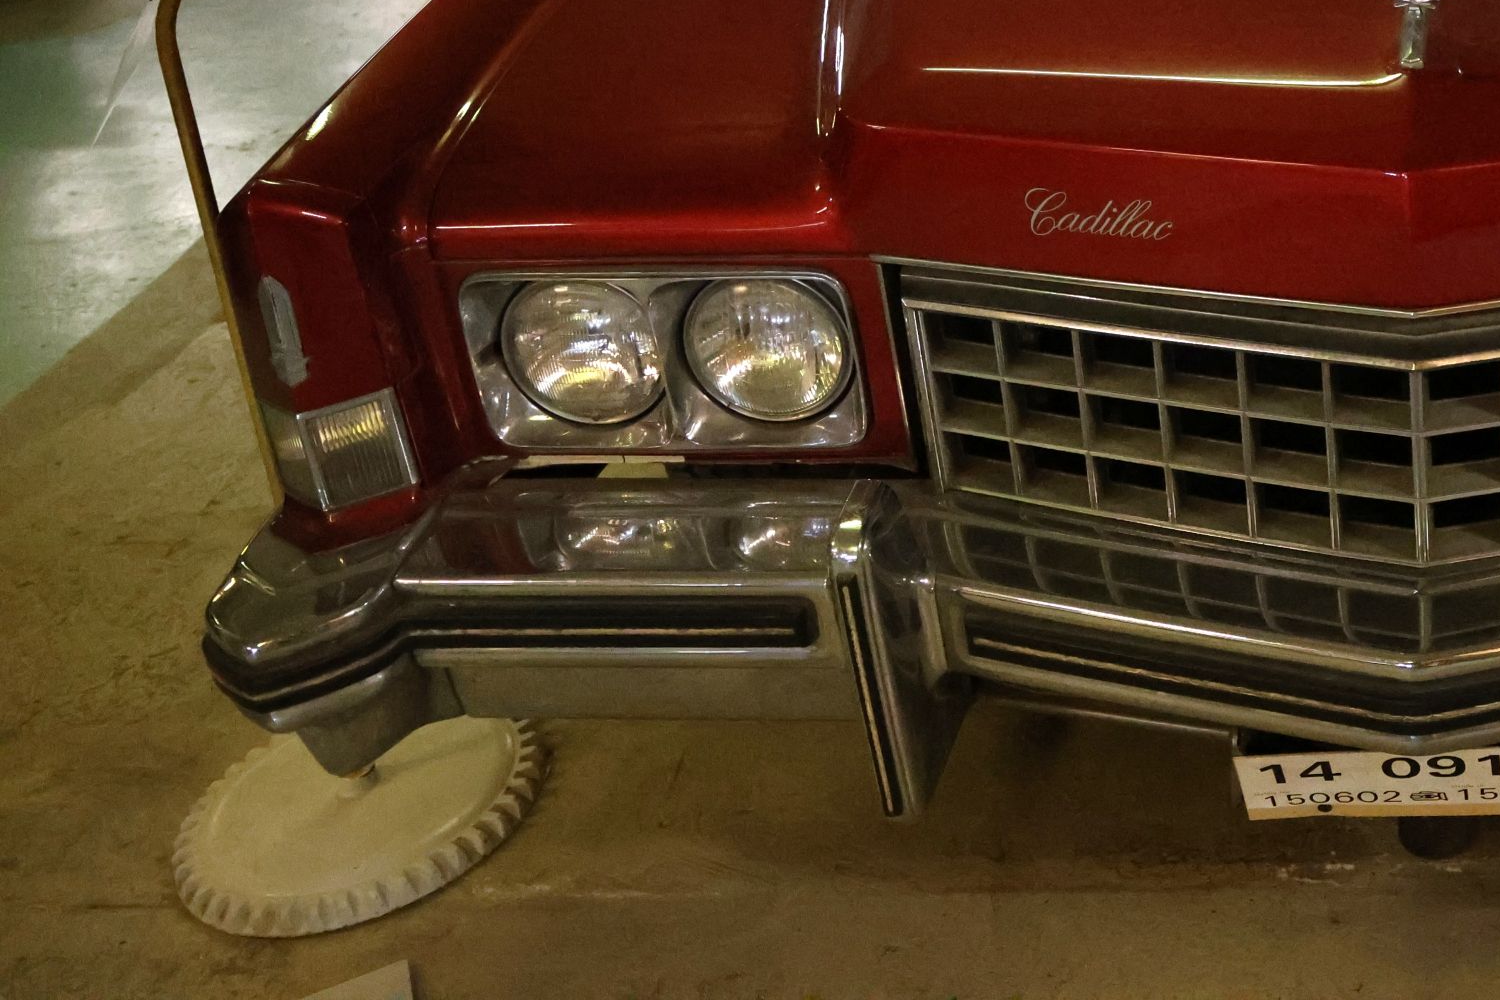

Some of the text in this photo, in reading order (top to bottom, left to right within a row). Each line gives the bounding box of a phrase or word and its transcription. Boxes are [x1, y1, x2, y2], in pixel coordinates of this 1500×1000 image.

[1024, 187, 1174, 241] Cadillac
[1259, 760, 1342, 785] 14
[1264, 789, 1402, 808] 150602
